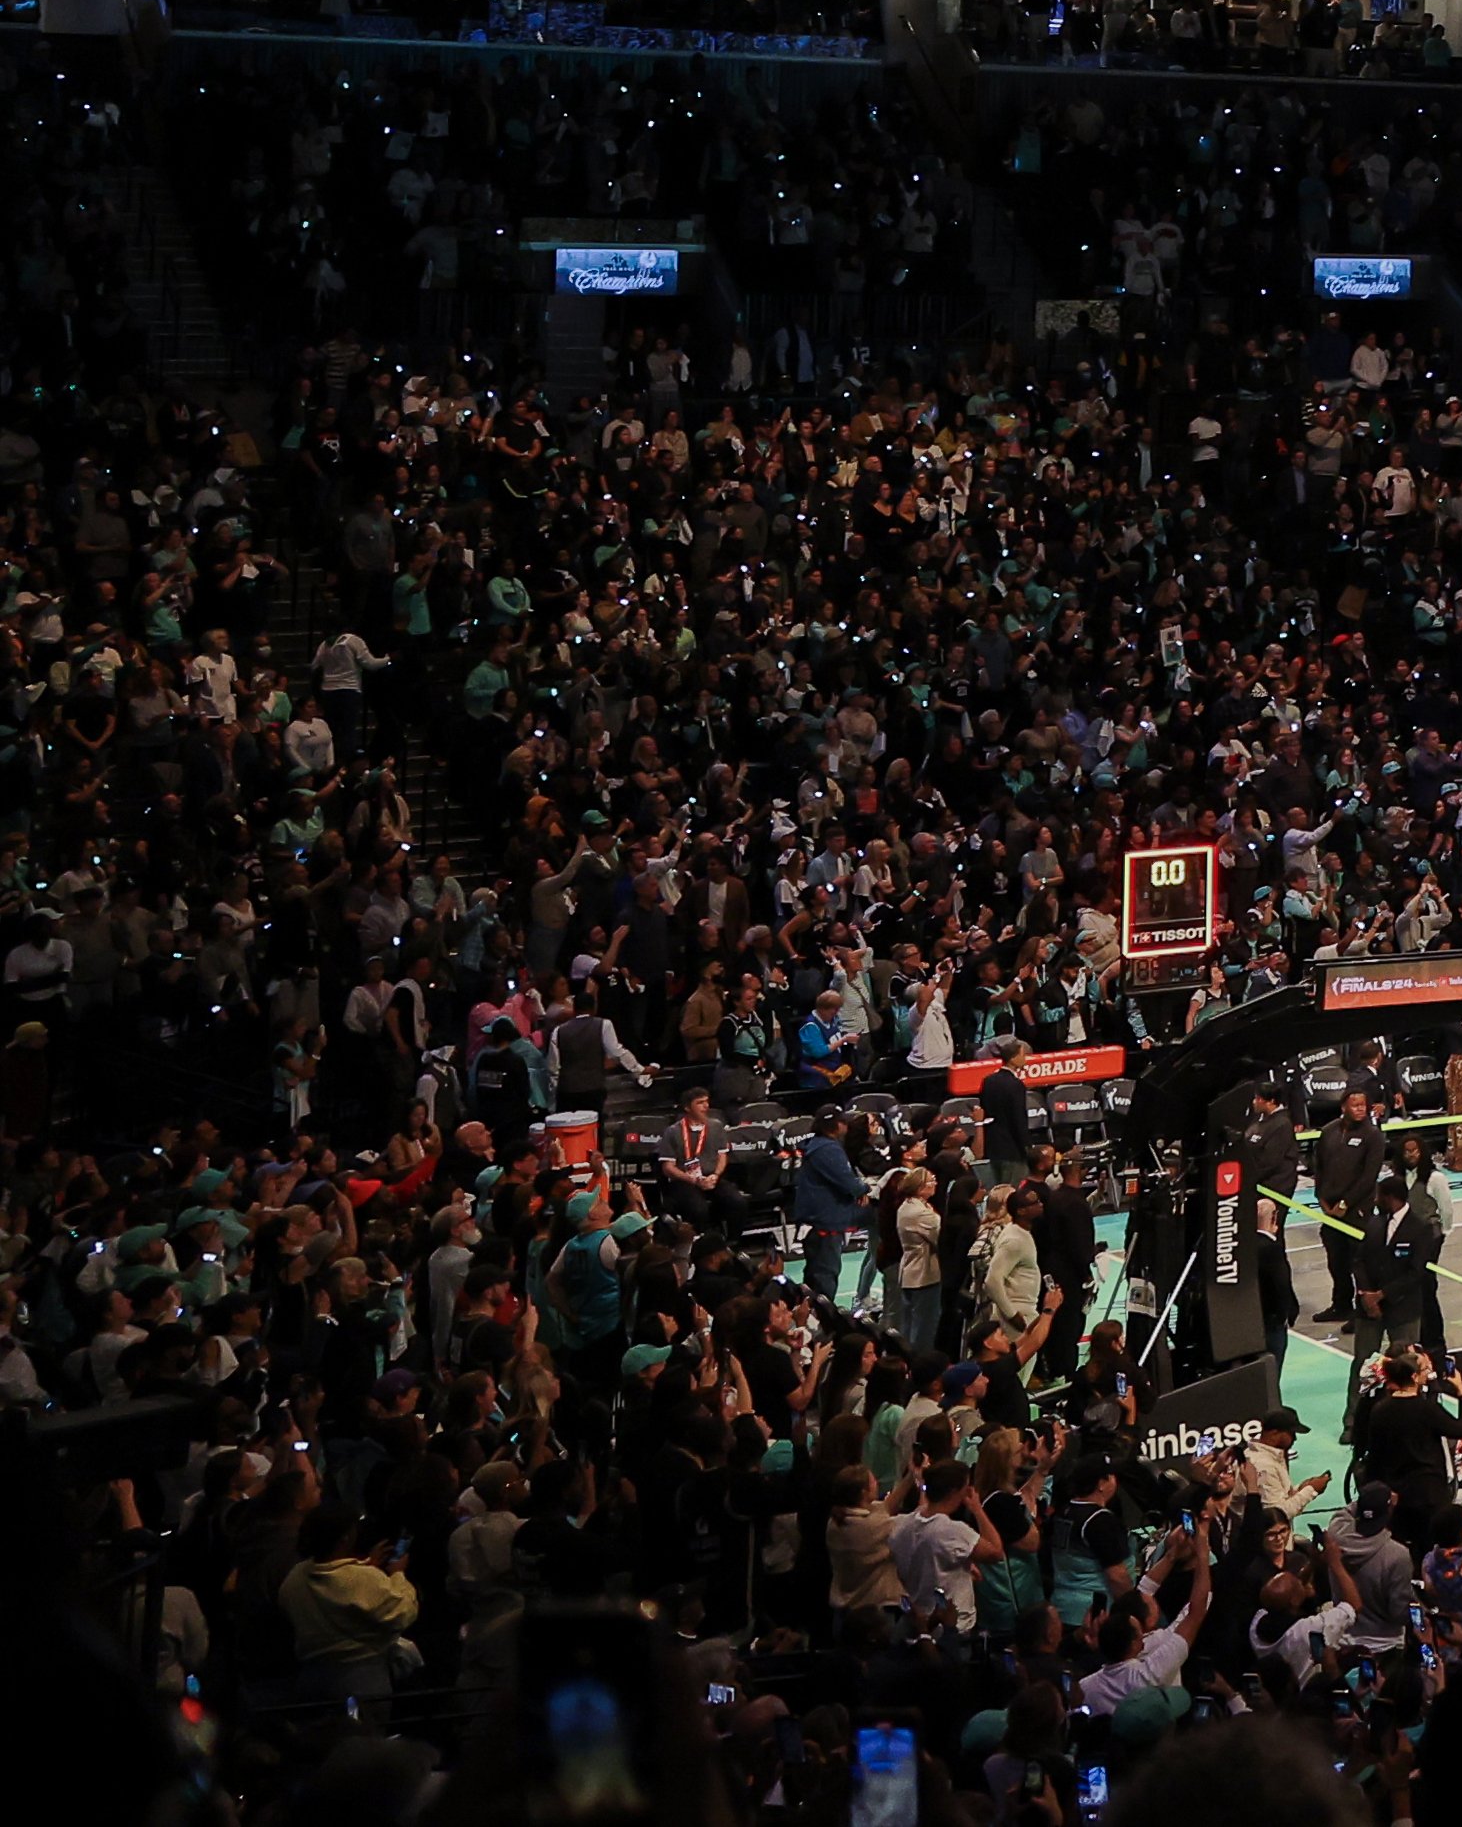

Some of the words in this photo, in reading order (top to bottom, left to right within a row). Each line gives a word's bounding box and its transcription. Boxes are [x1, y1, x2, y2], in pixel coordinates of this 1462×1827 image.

[1151, 859, 1185, 887] 0.0
[1152, 927, 1206, 942] TISSOT
[1411, 1070, 1443, 1084] WNBA
[1312, 1079, 1347, 1091] WNBA
